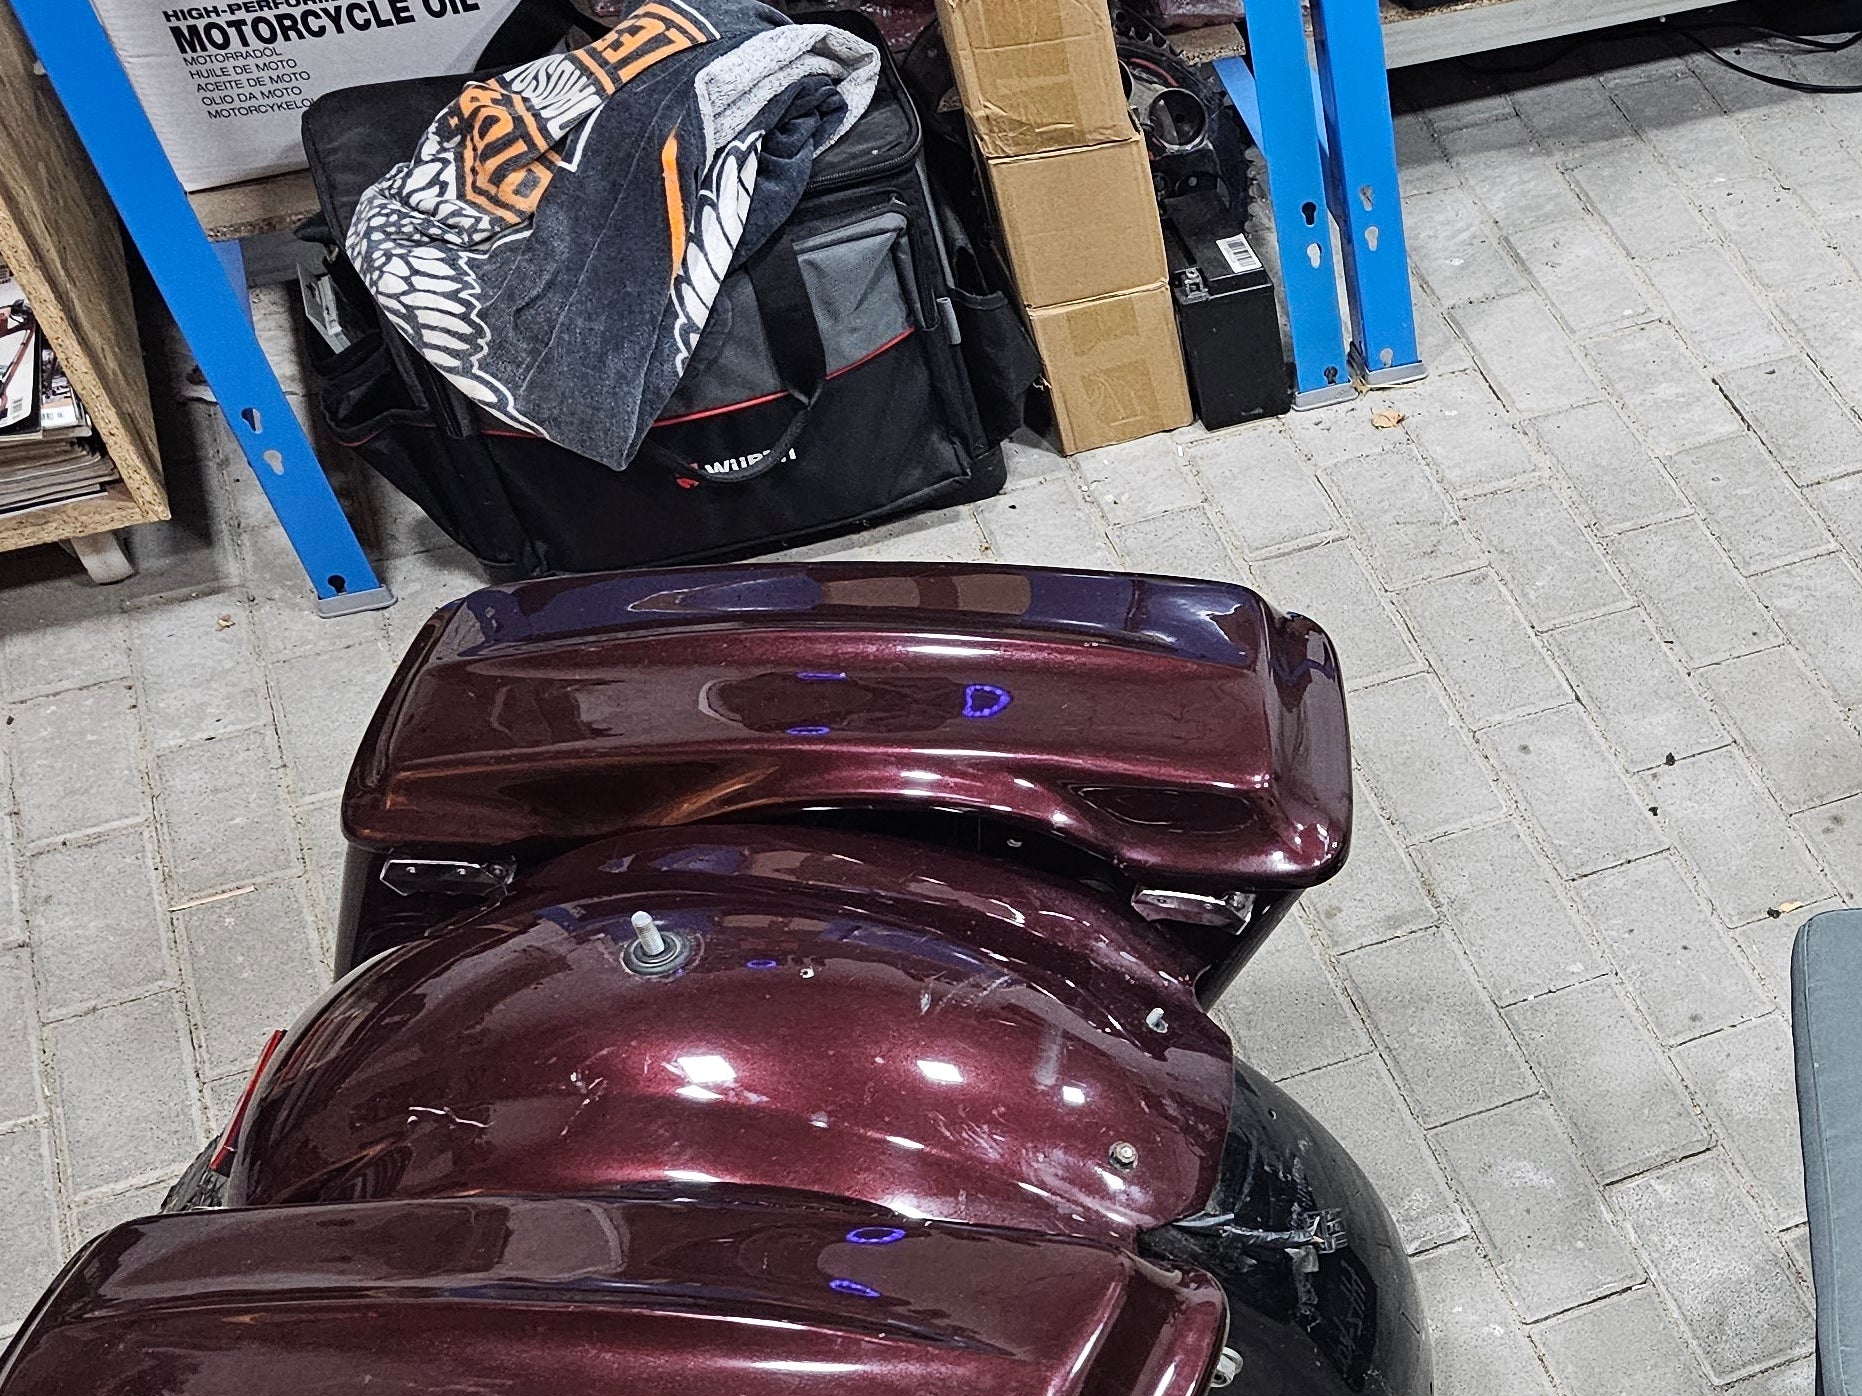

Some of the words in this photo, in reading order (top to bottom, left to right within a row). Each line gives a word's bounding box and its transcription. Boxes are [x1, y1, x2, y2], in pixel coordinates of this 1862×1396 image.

[169, 0, 416, 54] MOTORCYCLE
[189, 67, 231, 79] HUILE
[233, 64, 253, 75] DE
[255, 59, 297, 72] MOTO
[197, 80, 244, 93] ACEITE
[246, 77, 267, 87] DE
[269, 71, 310, 85] MOTO
[201, 94, 234, 106] OLIO
[237, 92, 259, 103] DA
[260, 86, 302, 100] MOTO
